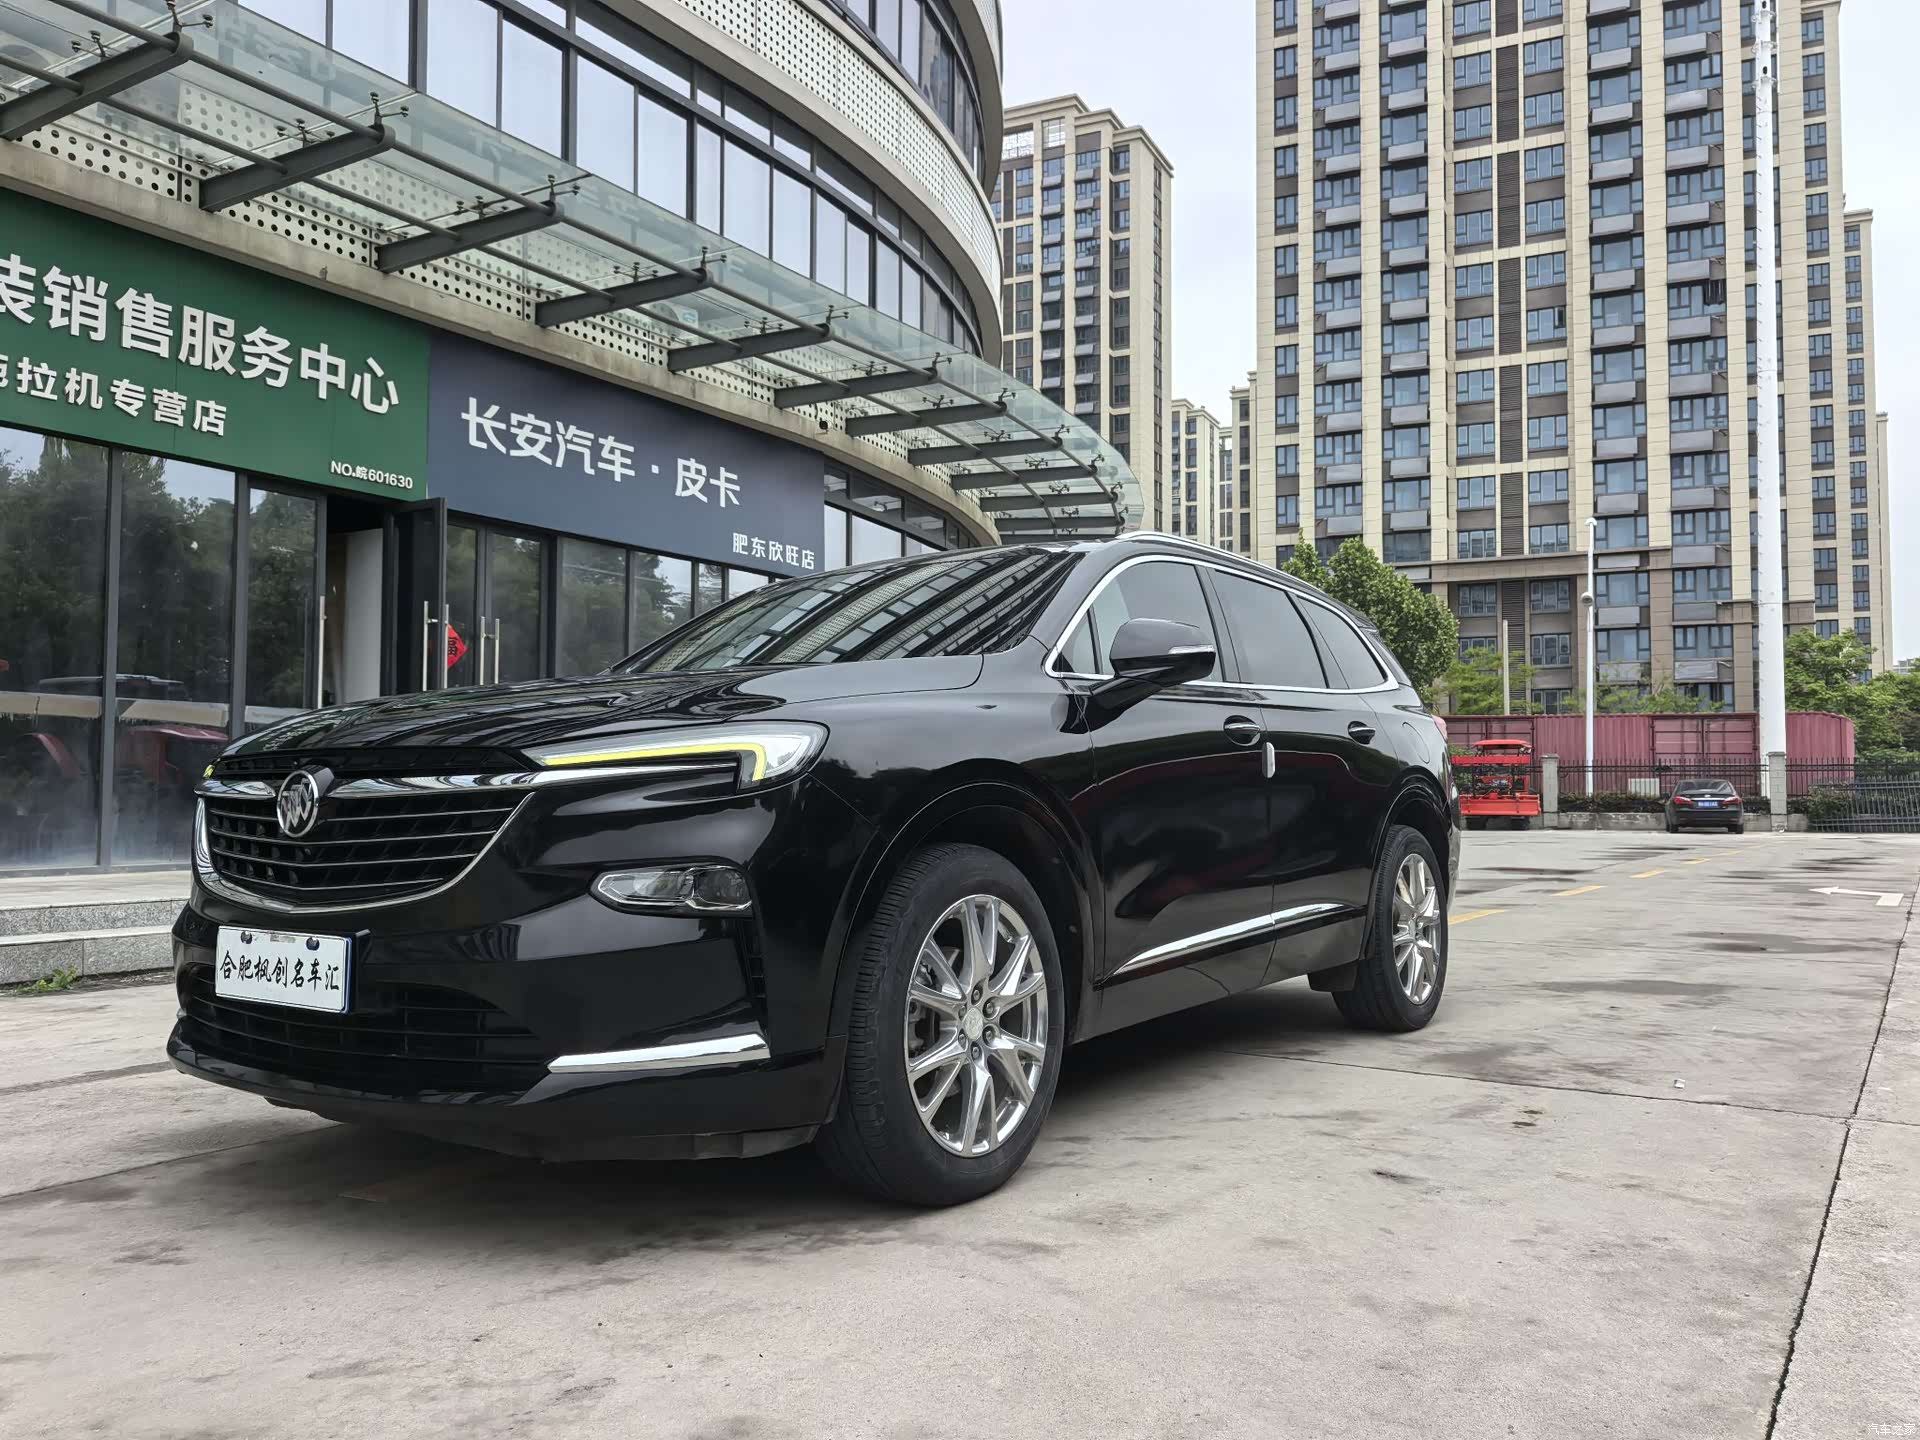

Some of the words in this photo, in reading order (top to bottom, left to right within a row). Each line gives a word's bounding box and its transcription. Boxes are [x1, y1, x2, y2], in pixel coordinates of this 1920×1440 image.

[0, 353, 227, 436] 拉机专营店
[732, 532, 816, 570] 肥东欣旺店
[219, 950, 340, 992] 合肥枫创名车汇
